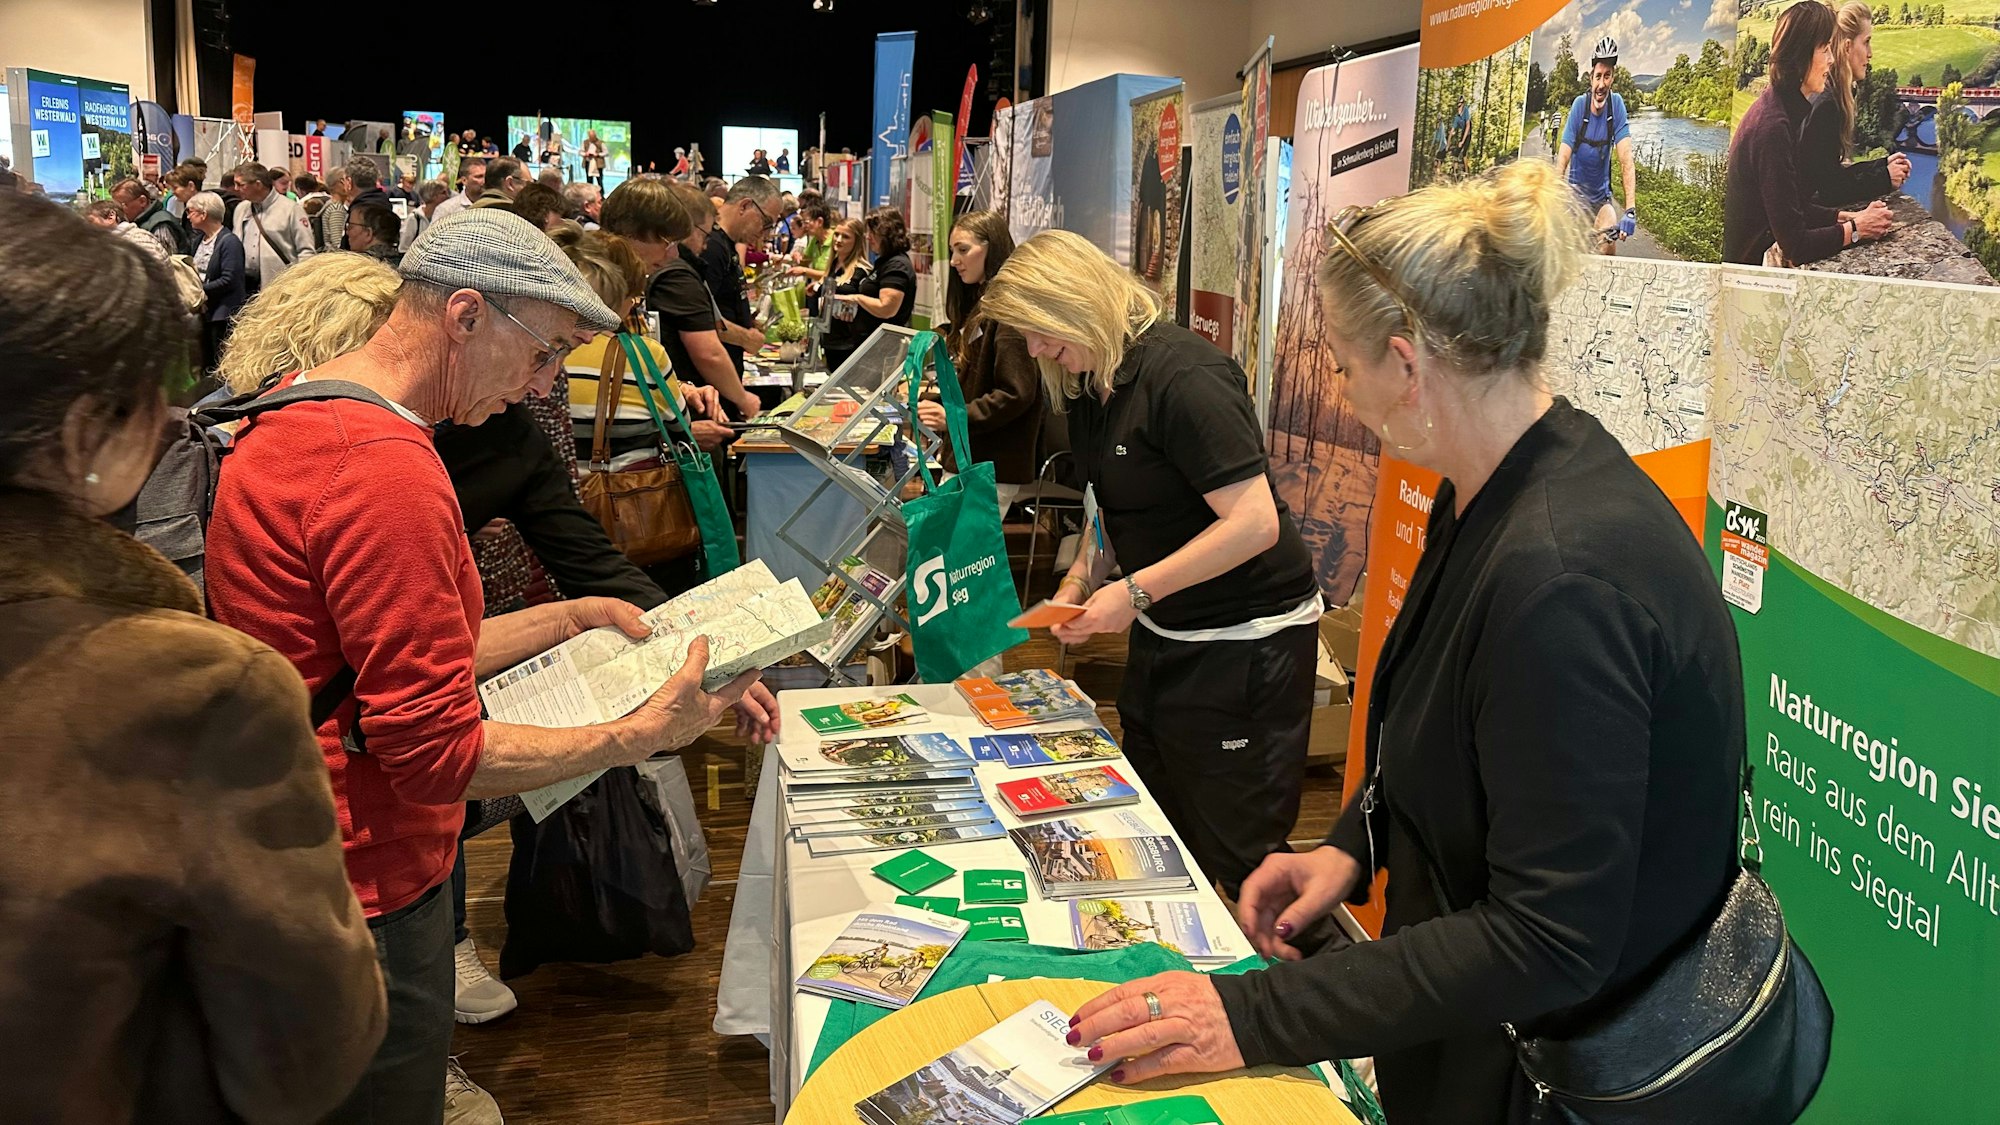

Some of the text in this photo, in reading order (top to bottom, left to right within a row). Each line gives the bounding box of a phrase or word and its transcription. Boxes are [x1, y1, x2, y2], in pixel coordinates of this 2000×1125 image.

[34, 108, 76, 124] WESTERWALD
[41, 96, 69, 110] ERLEBNIS
[84, 101, 126, 116] RADFAHREN IM
[85, 114, 127, 128] WESTERWALD
[1399, 479, 1435, 515] Radwe
[1396, 520, 1427, 553] und To
[948, 555, 996, 586] Naturregion
[951, 587, 970, 606] Sieg
[1768, 673, 2000, 840] Naturregion Sie
[1766, 731, 2000, 917] Raus aus dem Allt
[1762, 797, 1940, 948] rein ins Siegtal
[1040, 1010, 1071, 1036] SIEG
